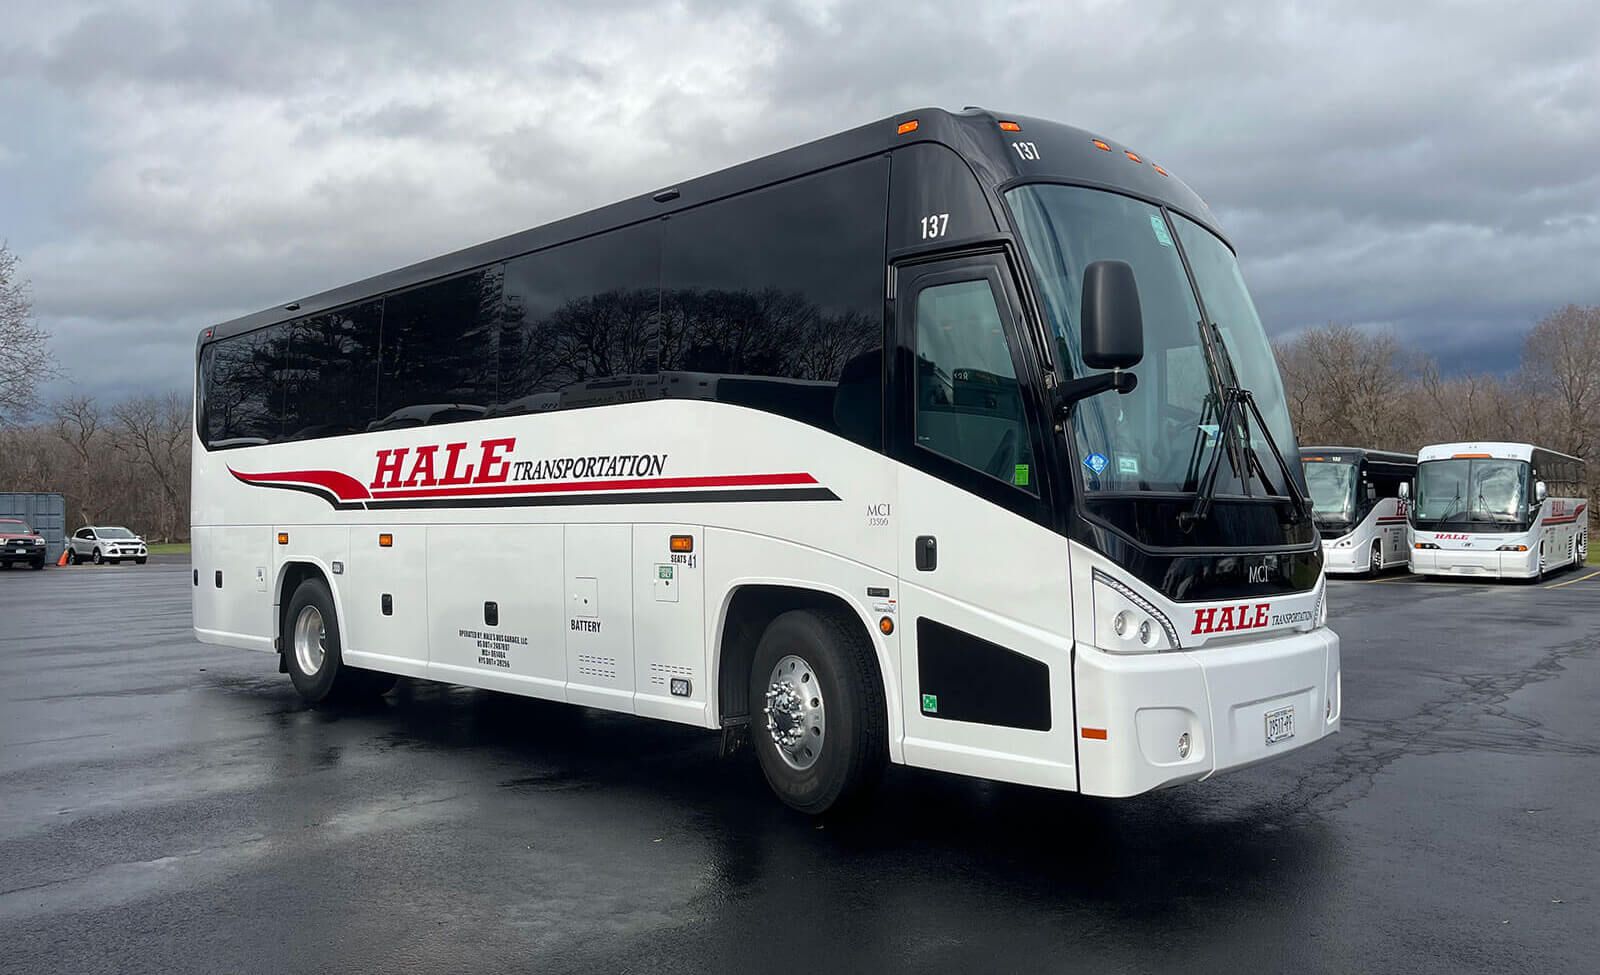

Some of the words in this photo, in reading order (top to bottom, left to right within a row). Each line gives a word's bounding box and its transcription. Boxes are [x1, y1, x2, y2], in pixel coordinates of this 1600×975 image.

[1012, 141, 1041, 161] 137
[921, 213, 949, 240] 137
[370, 438, 517, 489] HALE
[513, 454, 668, 482] TRANSPORTATION
[866, 503, 891, 517] MCI
[670, 554, 687, 564] SEATS
[687, 554, 697, 569] 41
[1248, 565, 1269, 583] MCI
[570, 619, 601, 633] BATTERY
[1191, 603, 1271, 635] HALE
